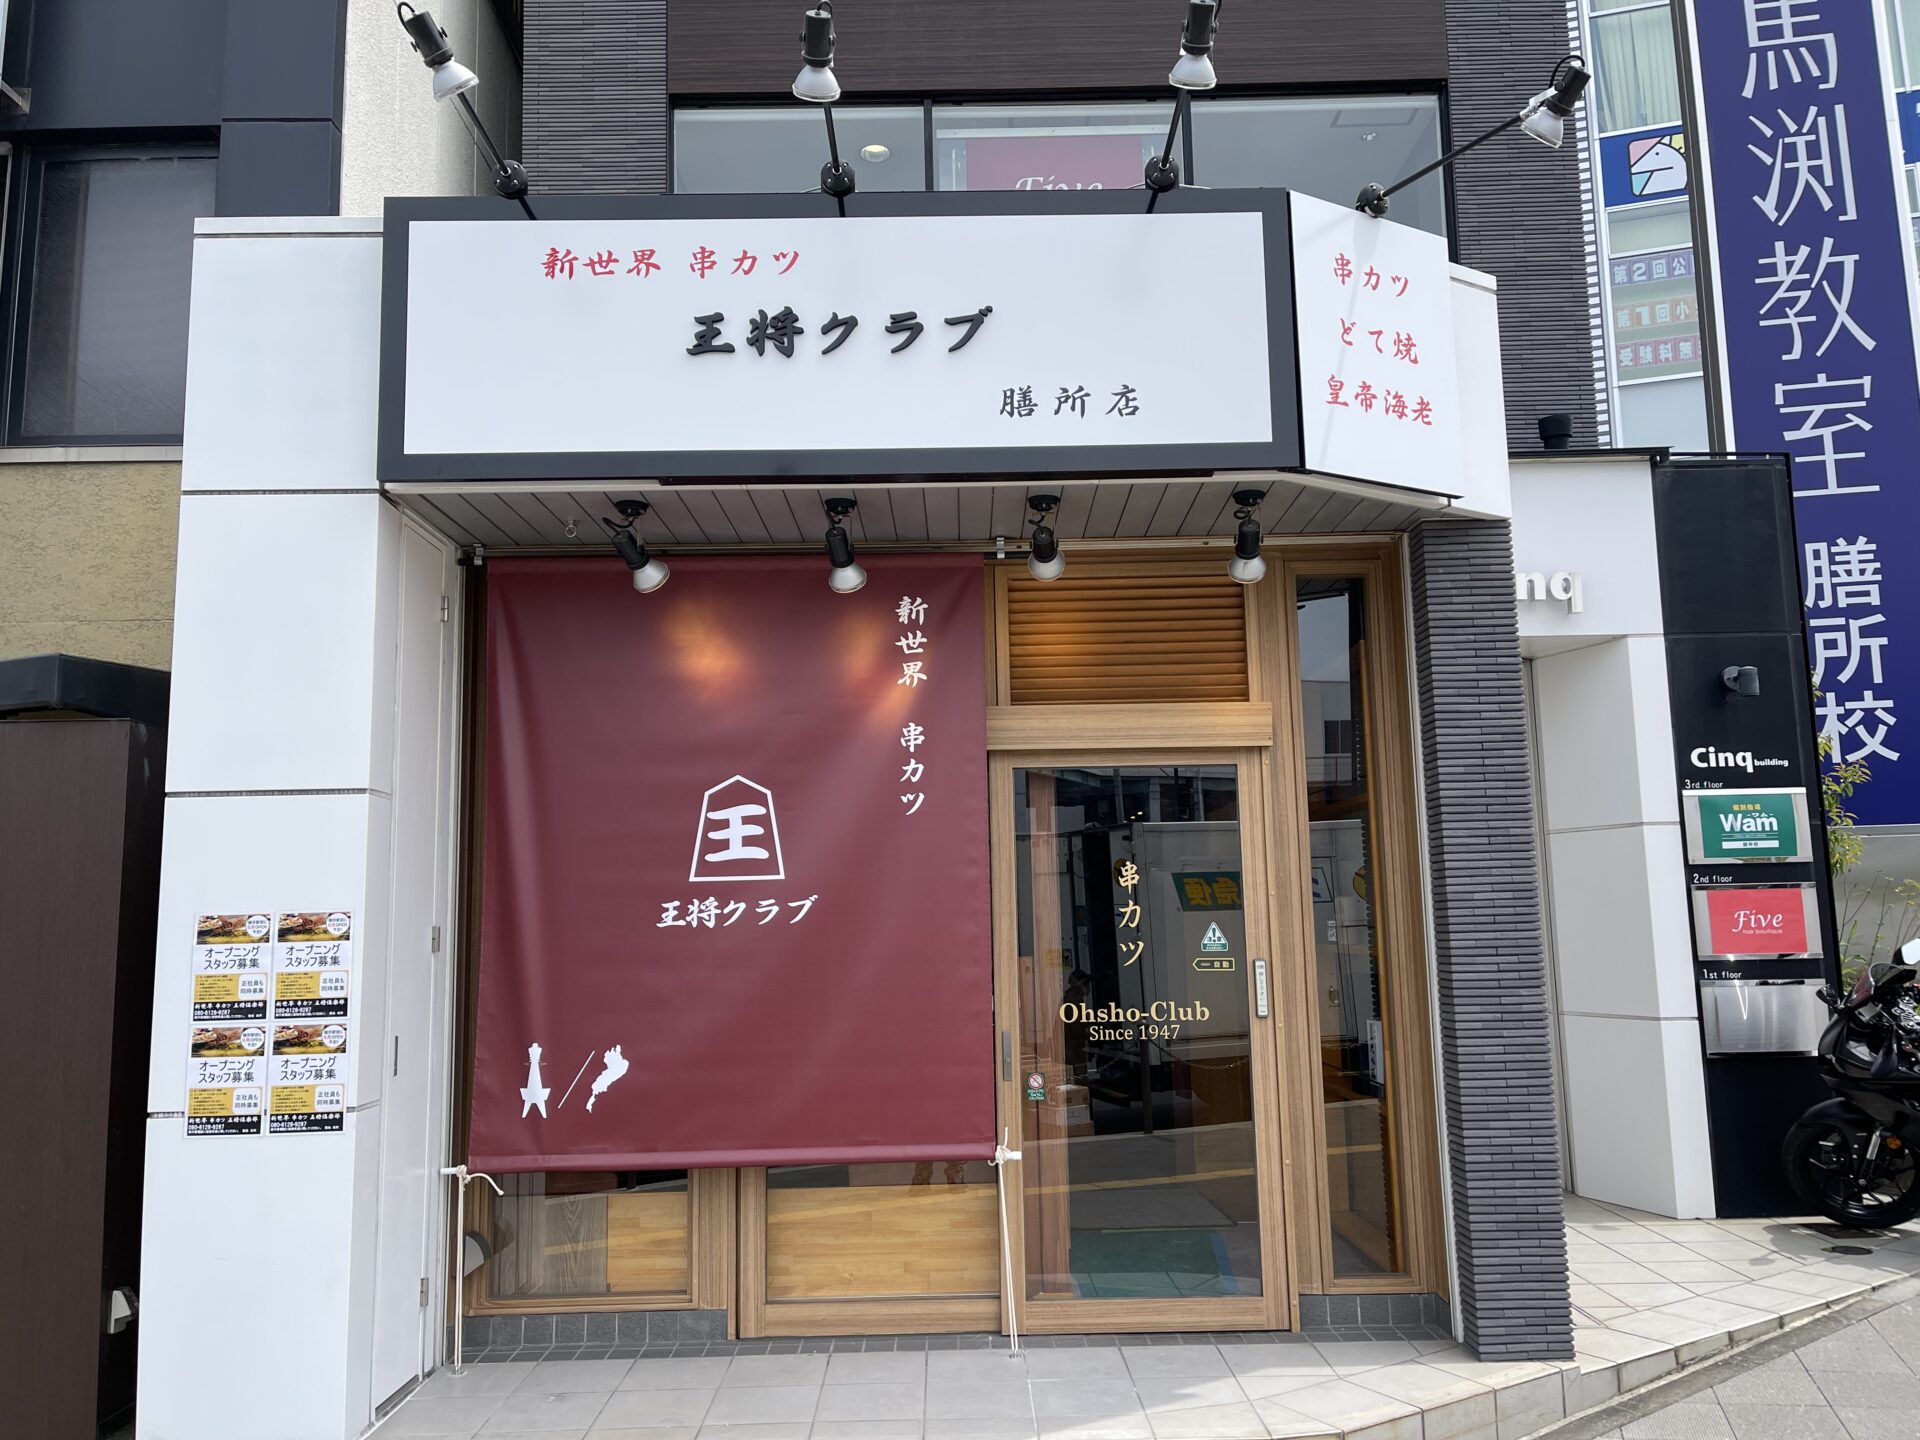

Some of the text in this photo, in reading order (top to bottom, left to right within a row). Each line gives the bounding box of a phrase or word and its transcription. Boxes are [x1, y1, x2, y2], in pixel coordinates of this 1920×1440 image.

[540, 246, 799, 280] 新世界 串カツ
[1333, 252, 1410, 299] 串カツ
[685, 305, 993, 359] 王将クラブ
[1338, 318, 1420, 366] どて焼
[1619, 340, 1700, 367] 受験料無
[1741, 0, 1900, 764] 馬渕教室 膳所校
[999, 384, 1140, 418] 膳所店
[1325, 373, 1434, 427] 皇帝海老
[1515, 571, 1583, 613] nq
[895, 596, 929, 816] 新世界 串カツ
[1690, 746, 1789, 773] Cinq building
[1684, 779, 1724, 789] 3rd floor
[705, 803, 770, 864] 王
[1719, 813, 1779, 832] Wam
[1693, 873, 1733, 883] 2nd floor
[656, 894, 819, 929] 王将クラブ
[1117, 860, 1145, 967] 串カツ
[1731, 910, 1783, 932] Five
[204, 946, 260, 958] オープニング
[285, 955, 340, 967] スタッフ募集
[286, 944, 340, 956] オープニング
[204, 958, 260, 970] スタッフ募集
[1703, 969, 1742, 979] 1st floor
[1059, 1001, 1210, 1023] Ohsho-Club
[1089, 1025, 1181, 1041] Since 1947
[199, 1060, 255, 1071] オープニング
[281, 1056, 337, 1069] オープニング
[198, 1071, 254, 1083] スタッフ募集
[280, 1068, 337, 1081] スタッフ募集
